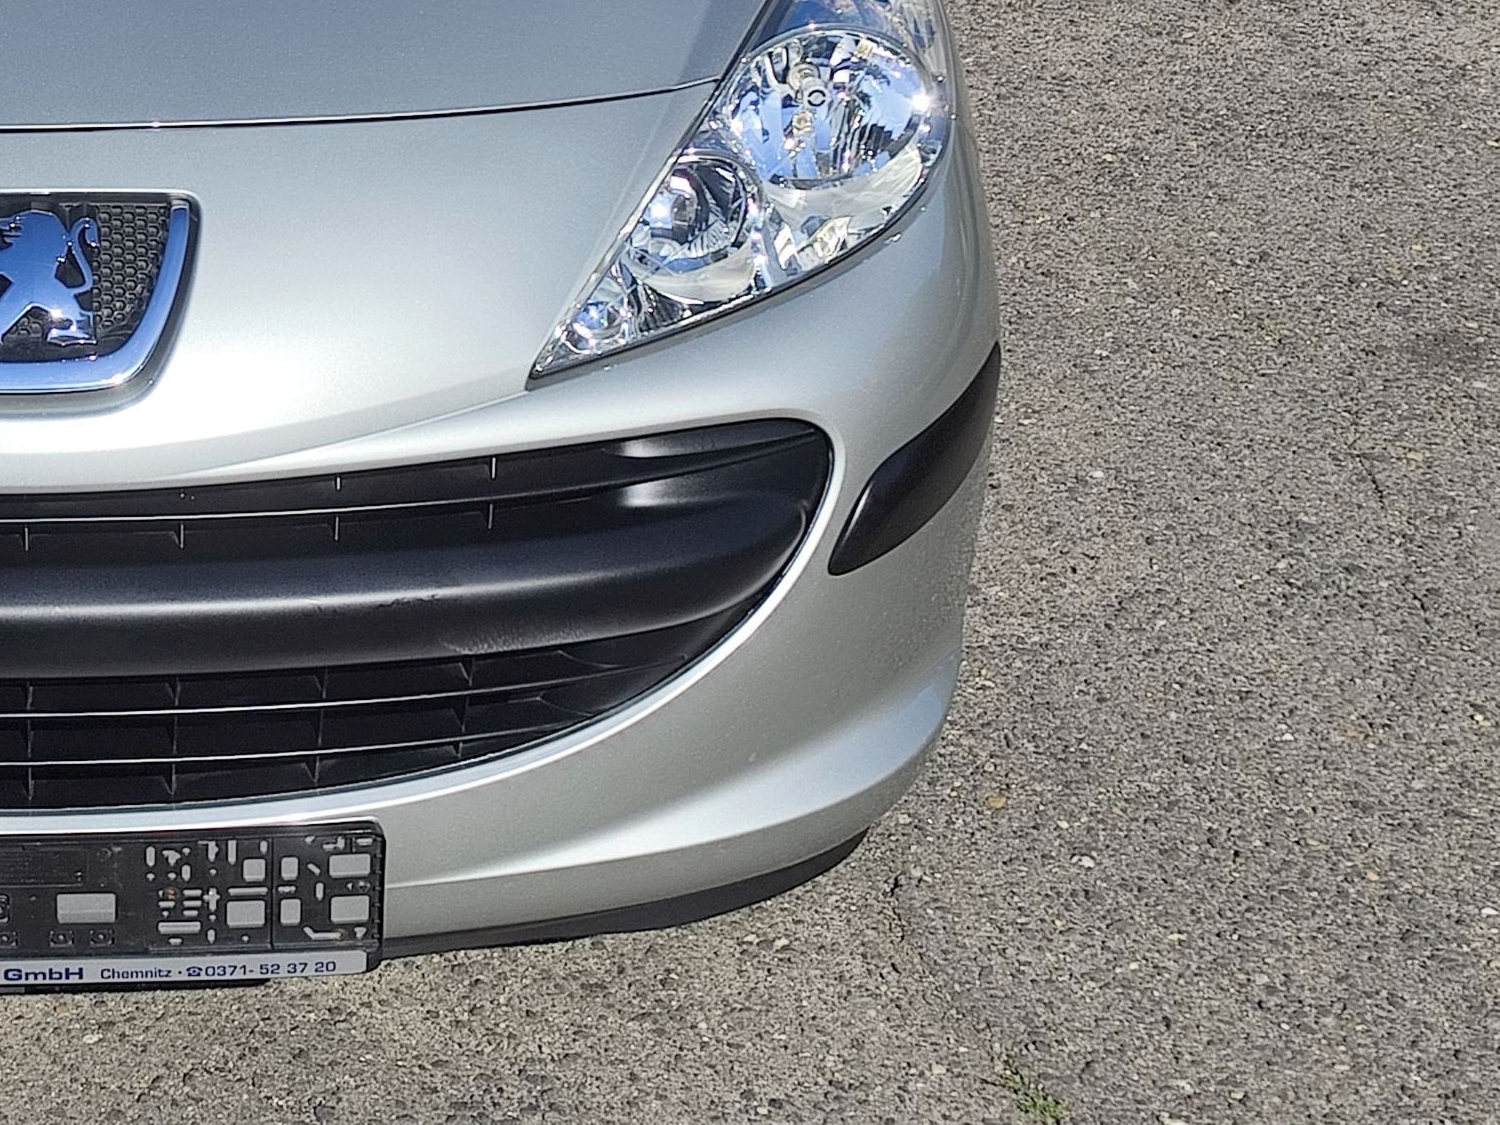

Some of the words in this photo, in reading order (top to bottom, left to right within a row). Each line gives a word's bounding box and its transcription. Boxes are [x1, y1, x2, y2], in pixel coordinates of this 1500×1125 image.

[3, 967, 84, 981] GmbH
[100, 967, 172, 980] Chemnitz
[259, 963, 281, 975] 52
[287, 961, 308, 974] 37
[314, 960, 336, 973] 20
